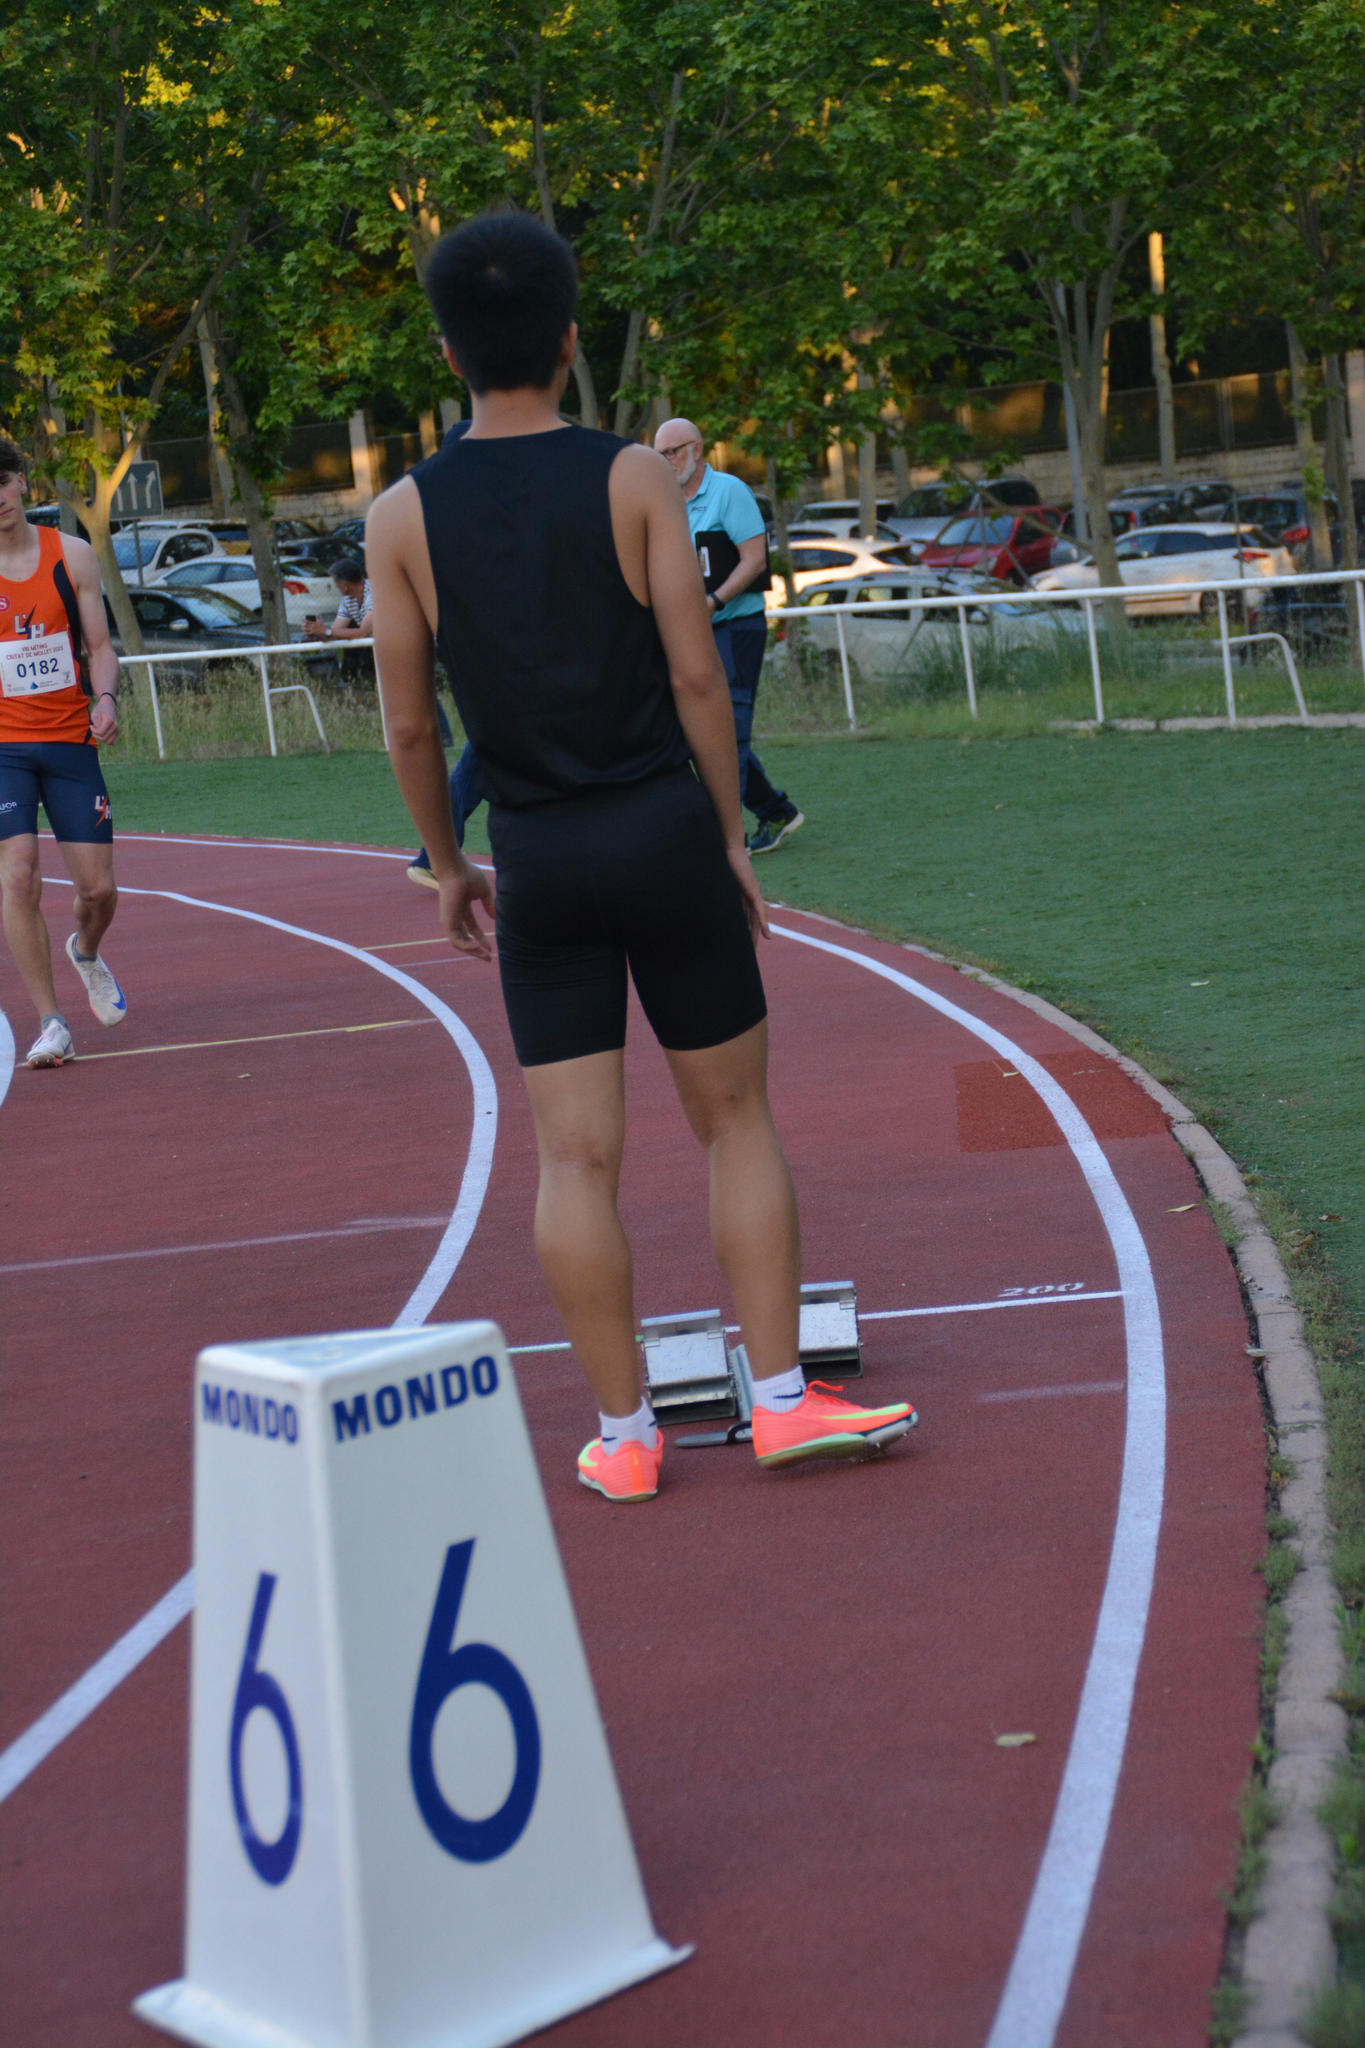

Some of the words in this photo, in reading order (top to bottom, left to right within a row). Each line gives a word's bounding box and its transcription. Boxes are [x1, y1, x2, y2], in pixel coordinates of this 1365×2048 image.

[17, 657, 59, 678] 0182
[996, 1282, 1085, 1298] 200
[202, 1382, 298, 1446] MONDO
[331, 1354, 500, 1444] MONDO
[228, 1571, 303, 1888] 6
[408, 1536, 543, 1865] 6
